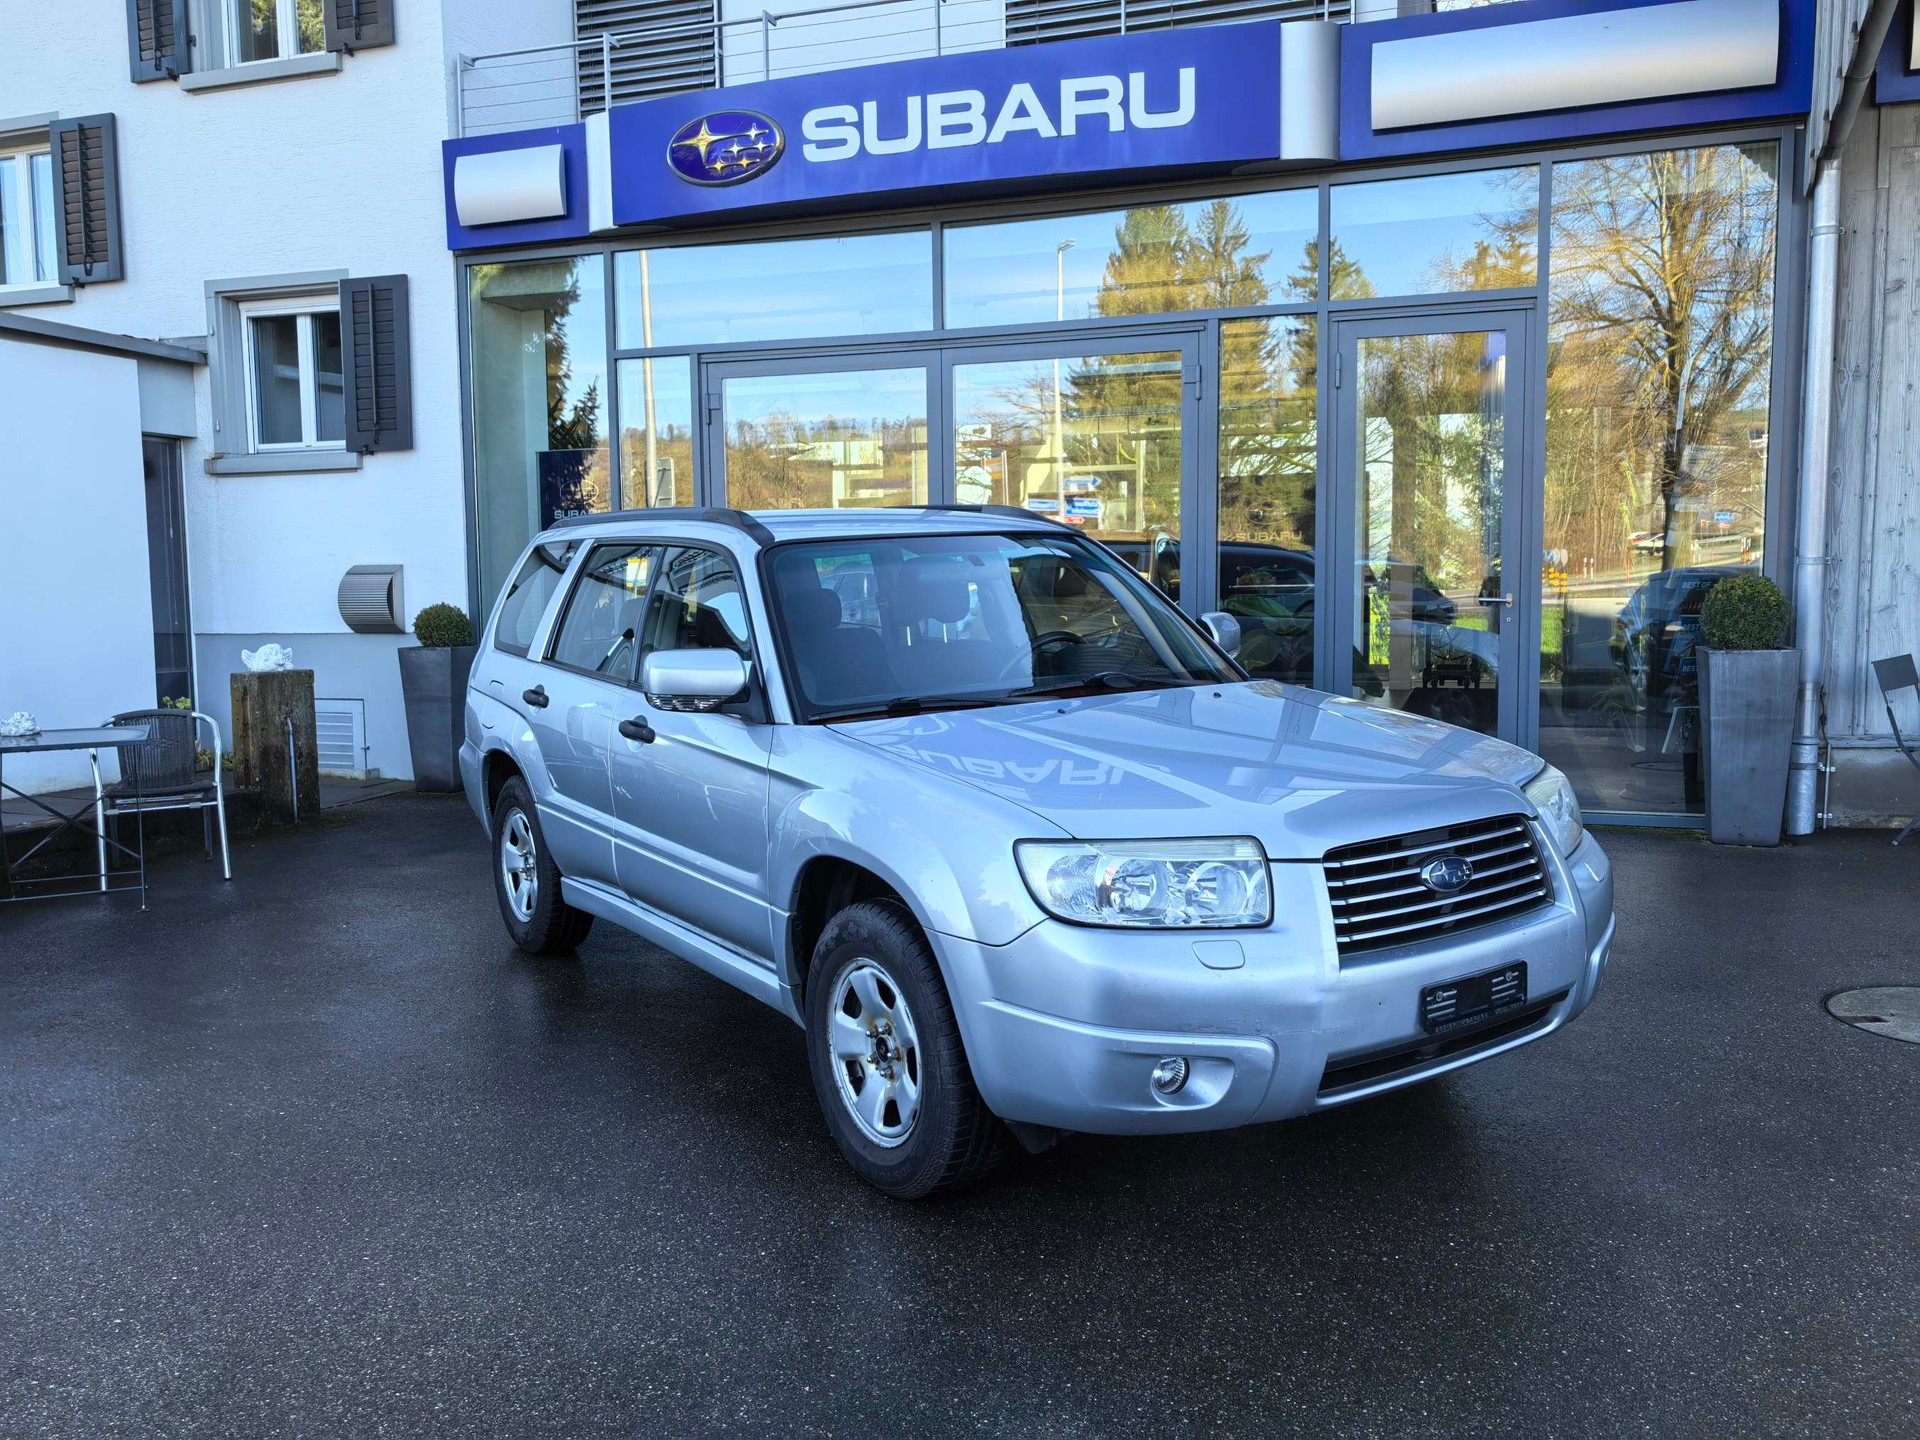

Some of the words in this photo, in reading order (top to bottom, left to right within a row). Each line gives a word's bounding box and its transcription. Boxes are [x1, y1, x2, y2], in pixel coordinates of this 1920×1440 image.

[801, 67, 1196, 163] SUBARU
[554, 509, 597, 520] SUBA
[1236, 531, 1302, 542] SUBARU
[1682, 581, 1701, 589] BEST
[1682, 665, 1697, 673] BES
